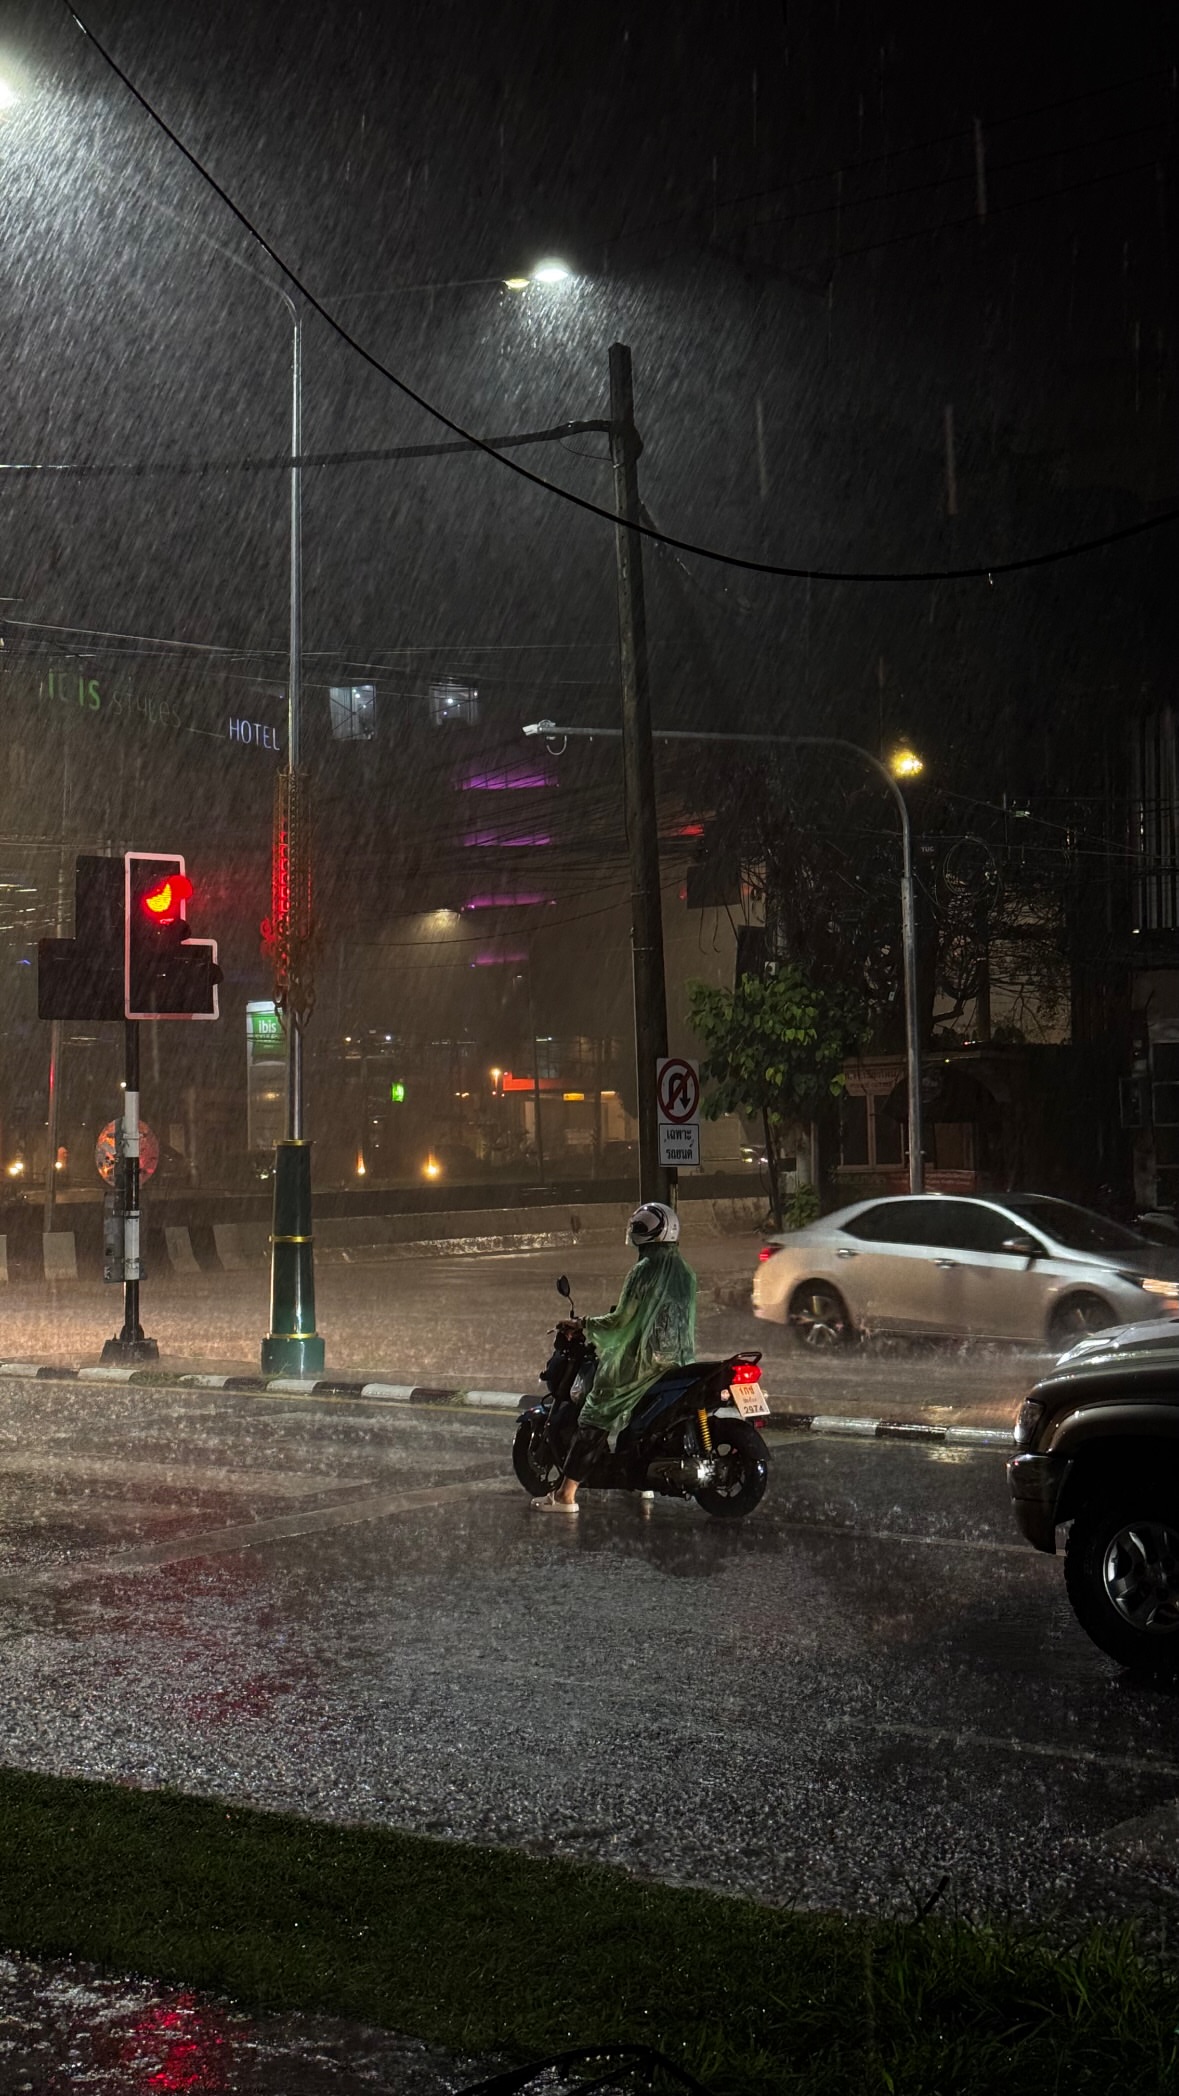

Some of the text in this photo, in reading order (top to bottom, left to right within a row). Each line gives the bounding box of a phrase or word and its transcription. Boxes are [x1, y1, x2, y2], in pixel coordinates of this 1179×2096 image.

[229, 717, 281, 751] HOTEL
[258, 1019, 277, 1034] ibis
[666, 1129, 692, 1140] เฉพาะ
[666, 1143, 693, 1160] รถยนต์
